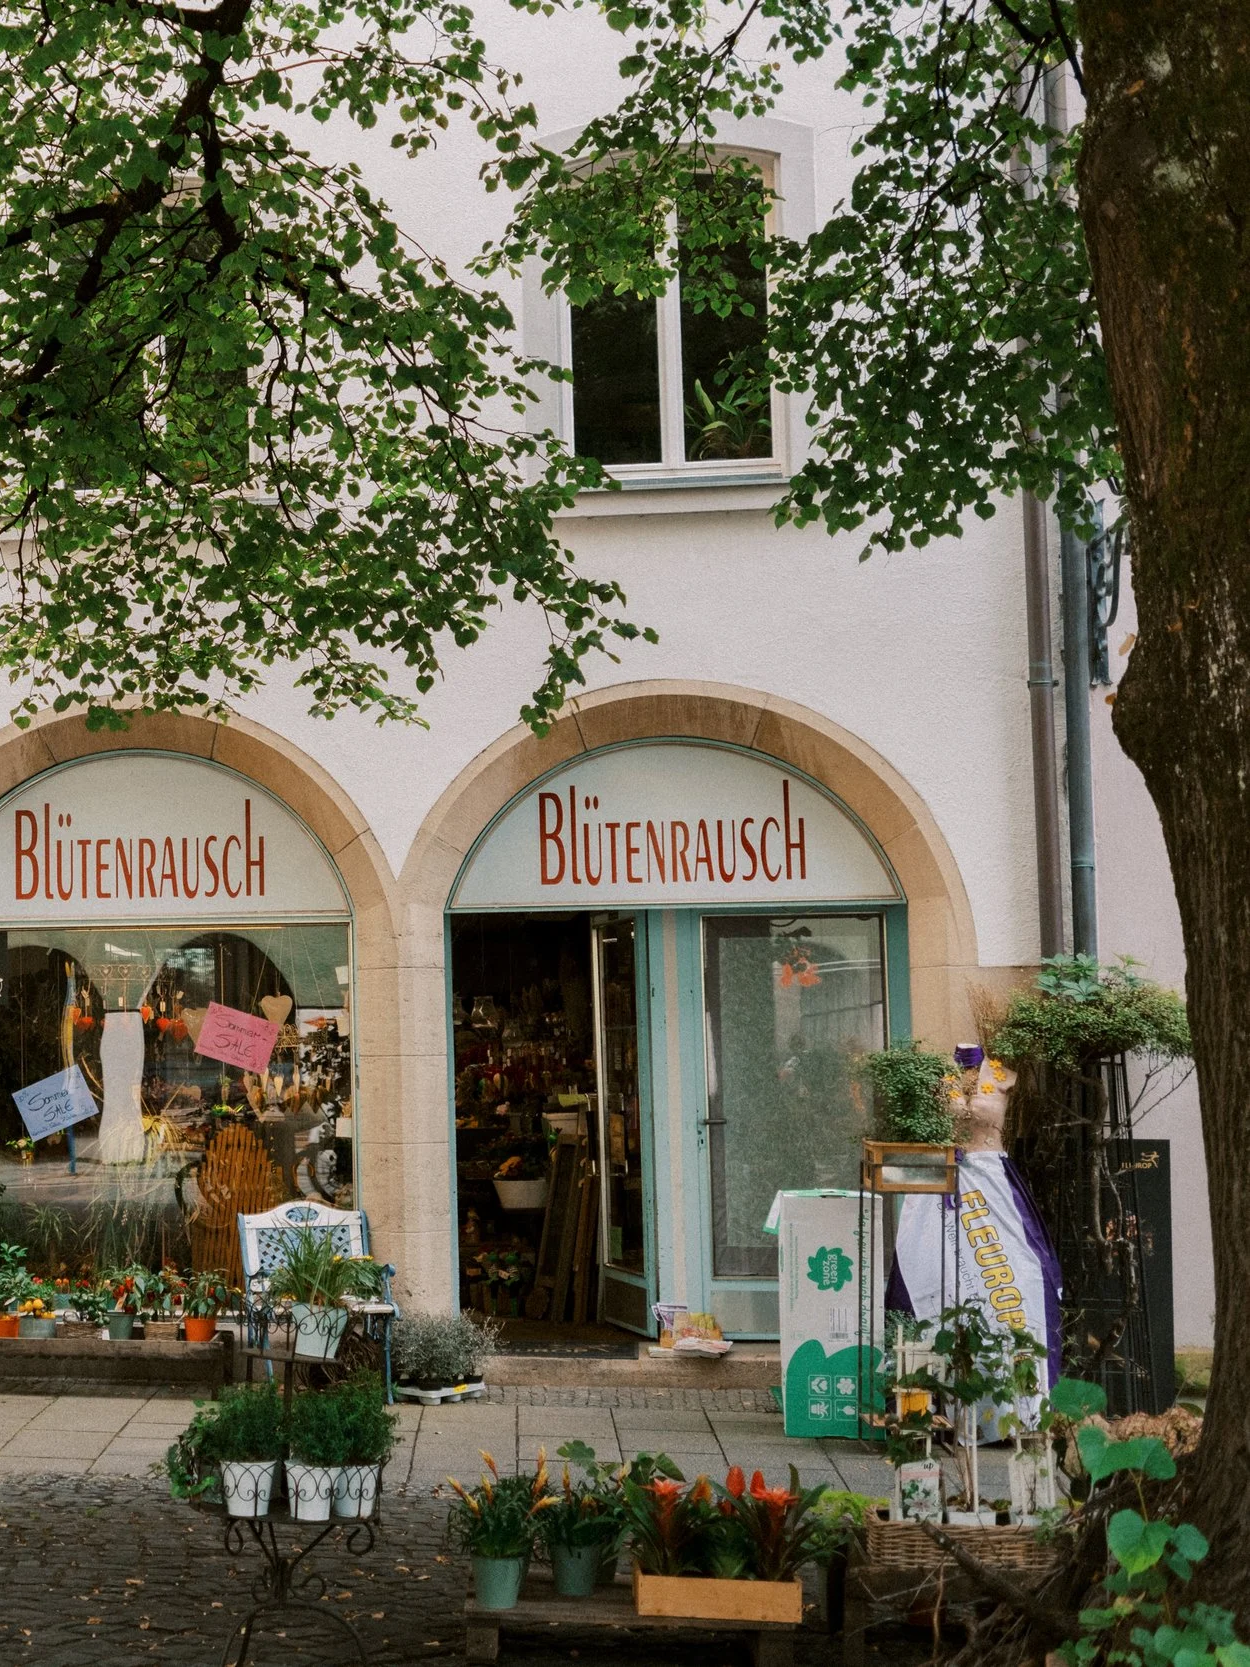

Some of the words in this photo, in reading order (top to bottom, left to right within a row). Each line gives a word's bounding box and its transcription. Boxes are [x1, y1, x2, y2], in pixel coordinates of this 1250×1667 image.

[213, 1033, 256, 1058] SALE
[43, 1098, 74, 1123] SALE
[827, 1253, 838, 1284] green
[960, 1189, 1027, 1330] FLEUROP
[822, 1260, 830, 1286] zone
